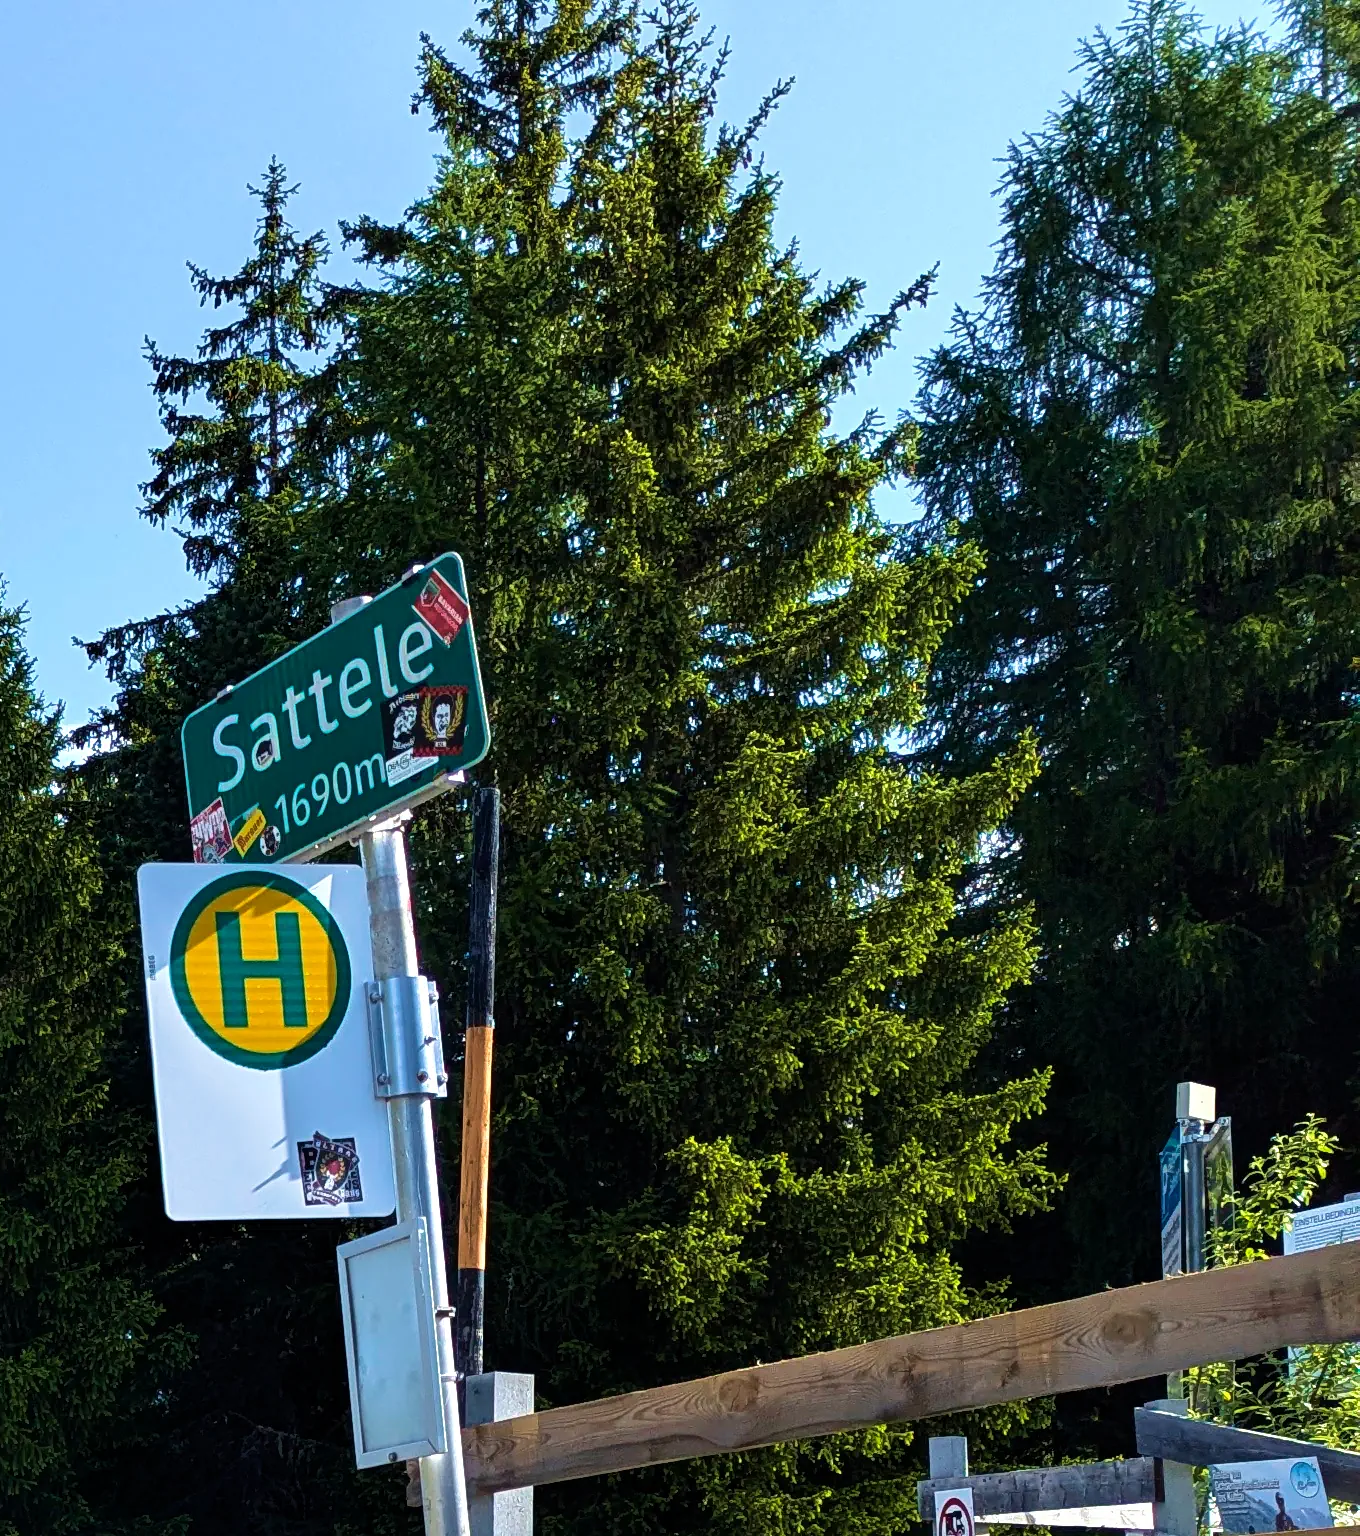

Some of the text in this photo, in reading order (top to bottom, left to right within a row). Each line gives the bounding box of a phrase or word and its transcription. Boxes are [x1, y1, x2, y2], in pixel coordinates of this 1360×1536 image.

[212, 620, 435, 793] Sattele
[274, 752, 386, 834] 1690m
[214, 911, 308, 1028] H
